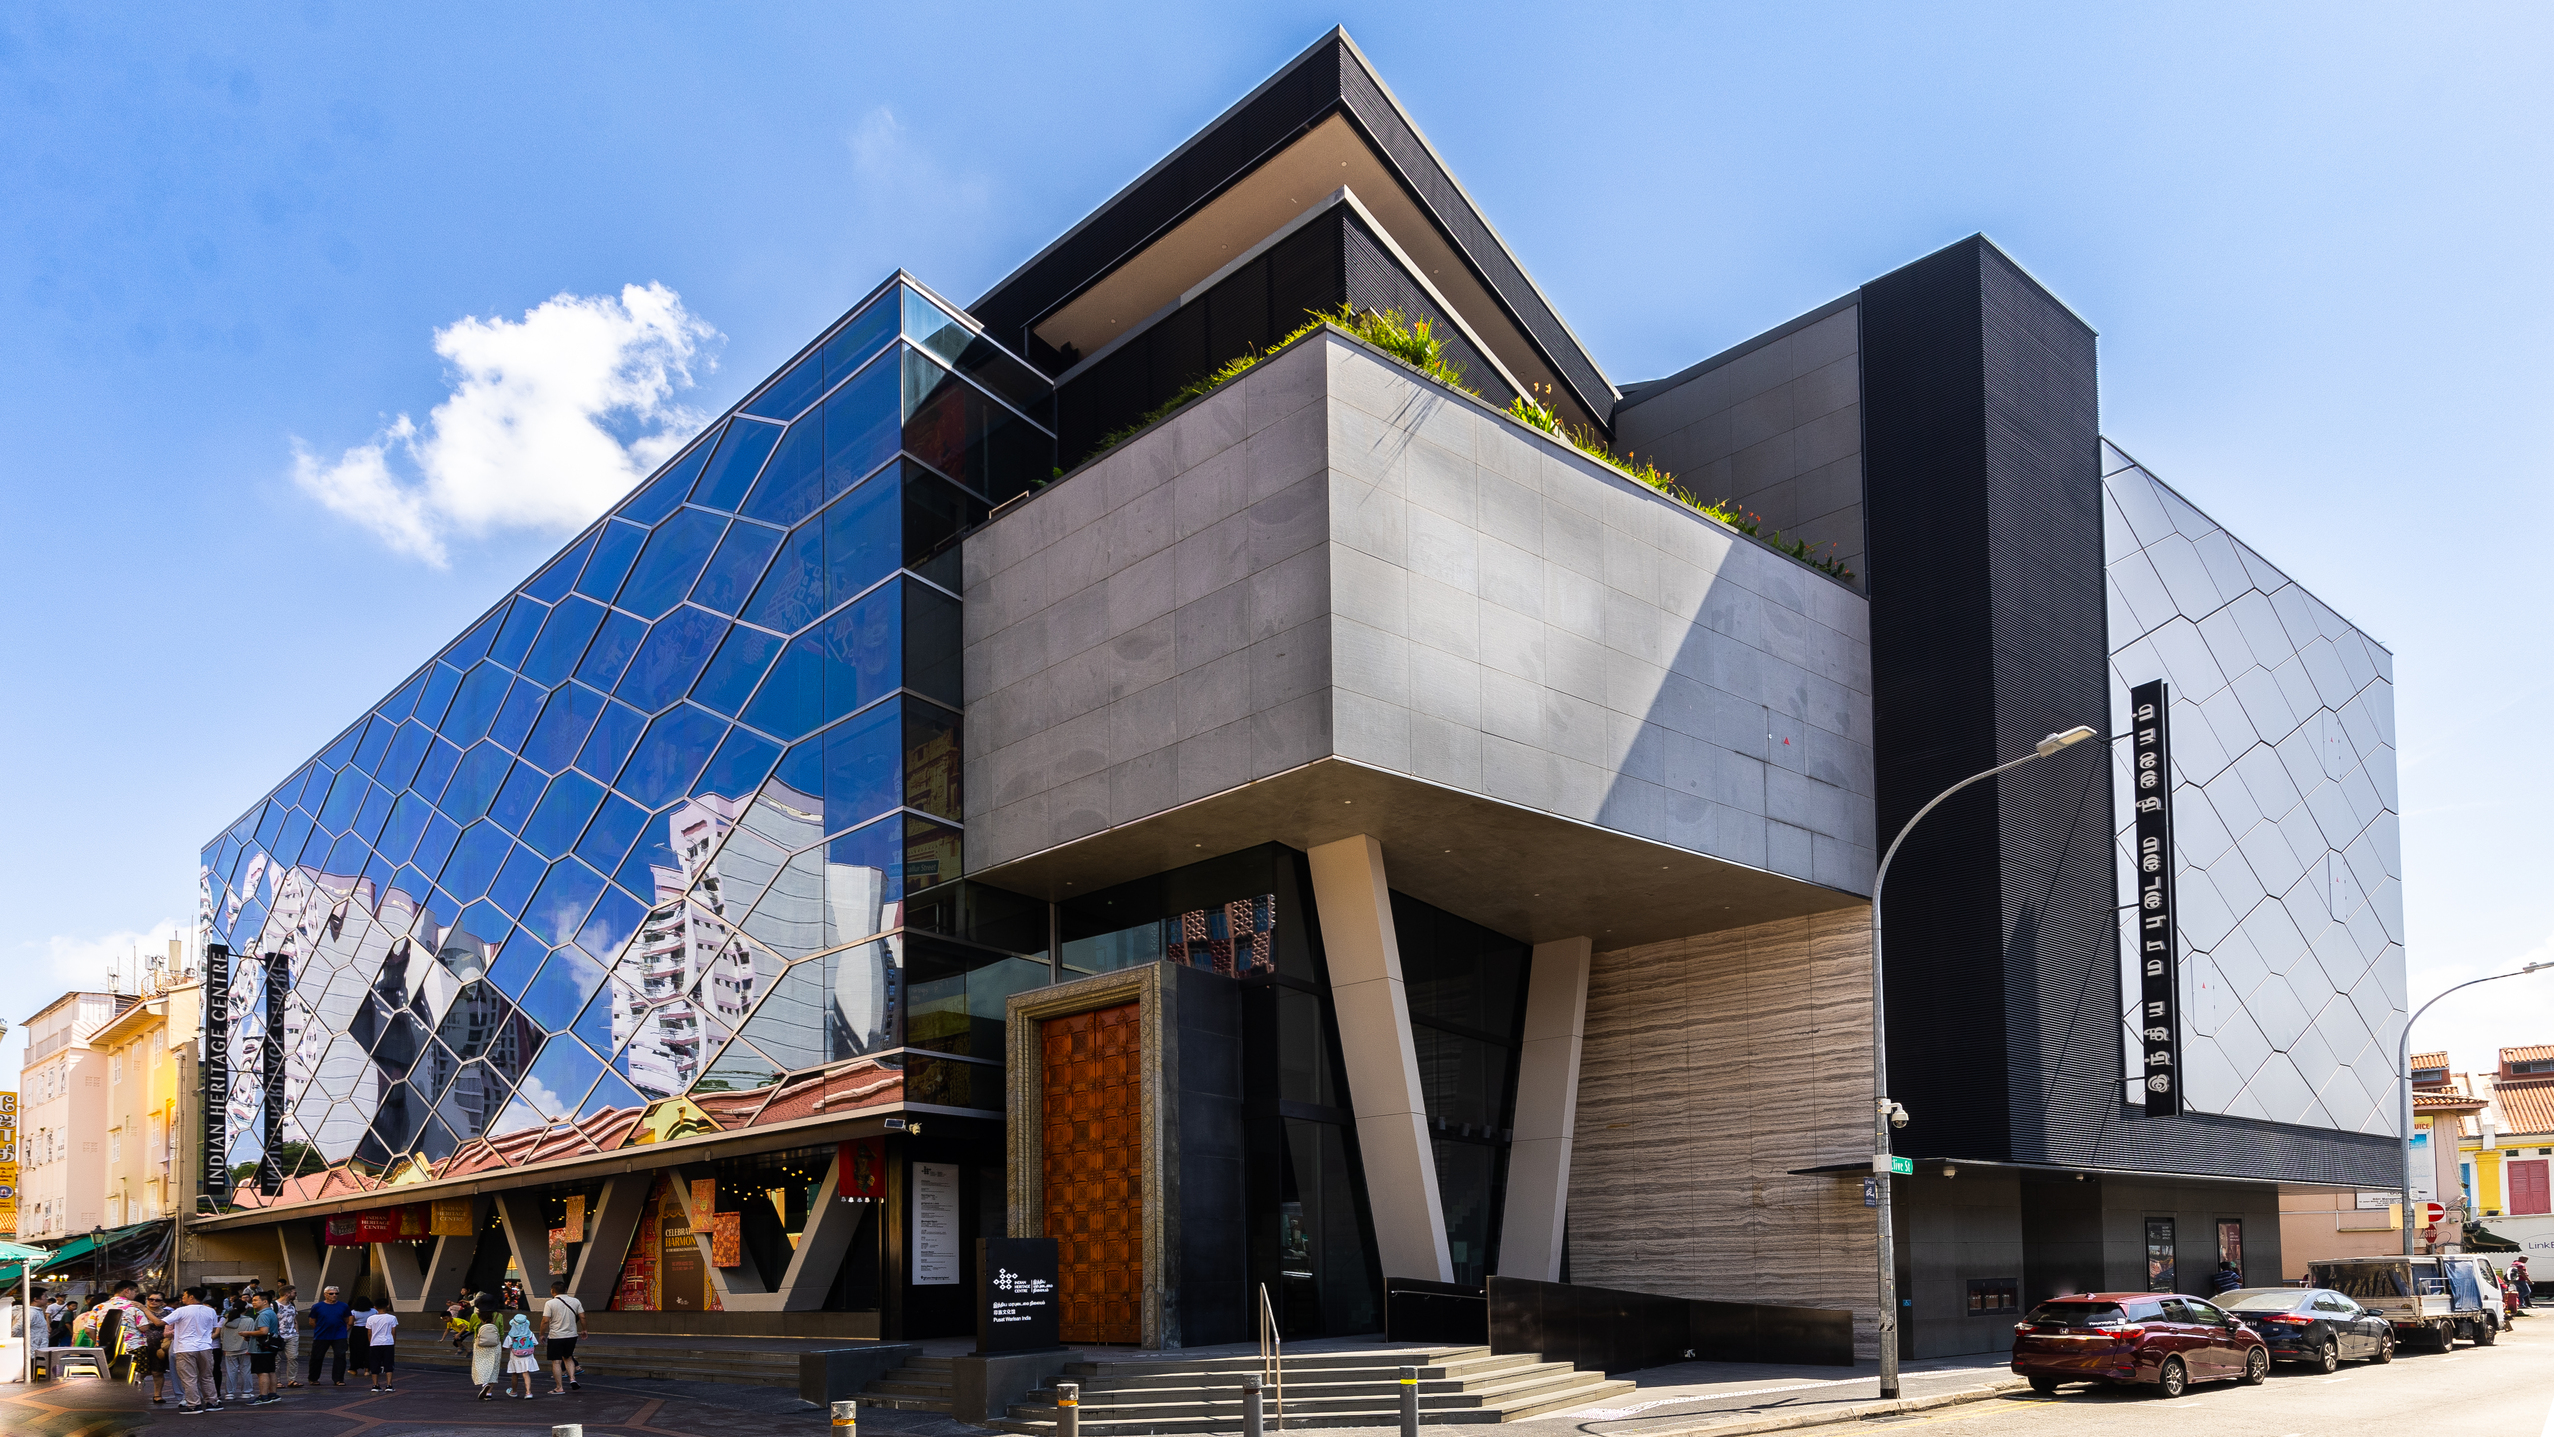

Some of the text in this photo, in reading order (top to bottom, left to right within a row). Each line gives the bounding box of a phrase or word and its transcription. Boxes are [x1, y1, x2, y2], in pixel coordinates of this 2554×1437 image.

[2131, 704, 2172, 1093] இந்திய மரபுடைமை நிலையம்
[209, 951, 228, 1185] INDIAN HERITAGE CENTRE
[1892, 1159, 1911, 1172] live St
[665, 1227, 691, 1237] CELEBRAT
[2425, 1229, 2437, 1238] STOP
[665, 1236, 696, 1247] HARMON
